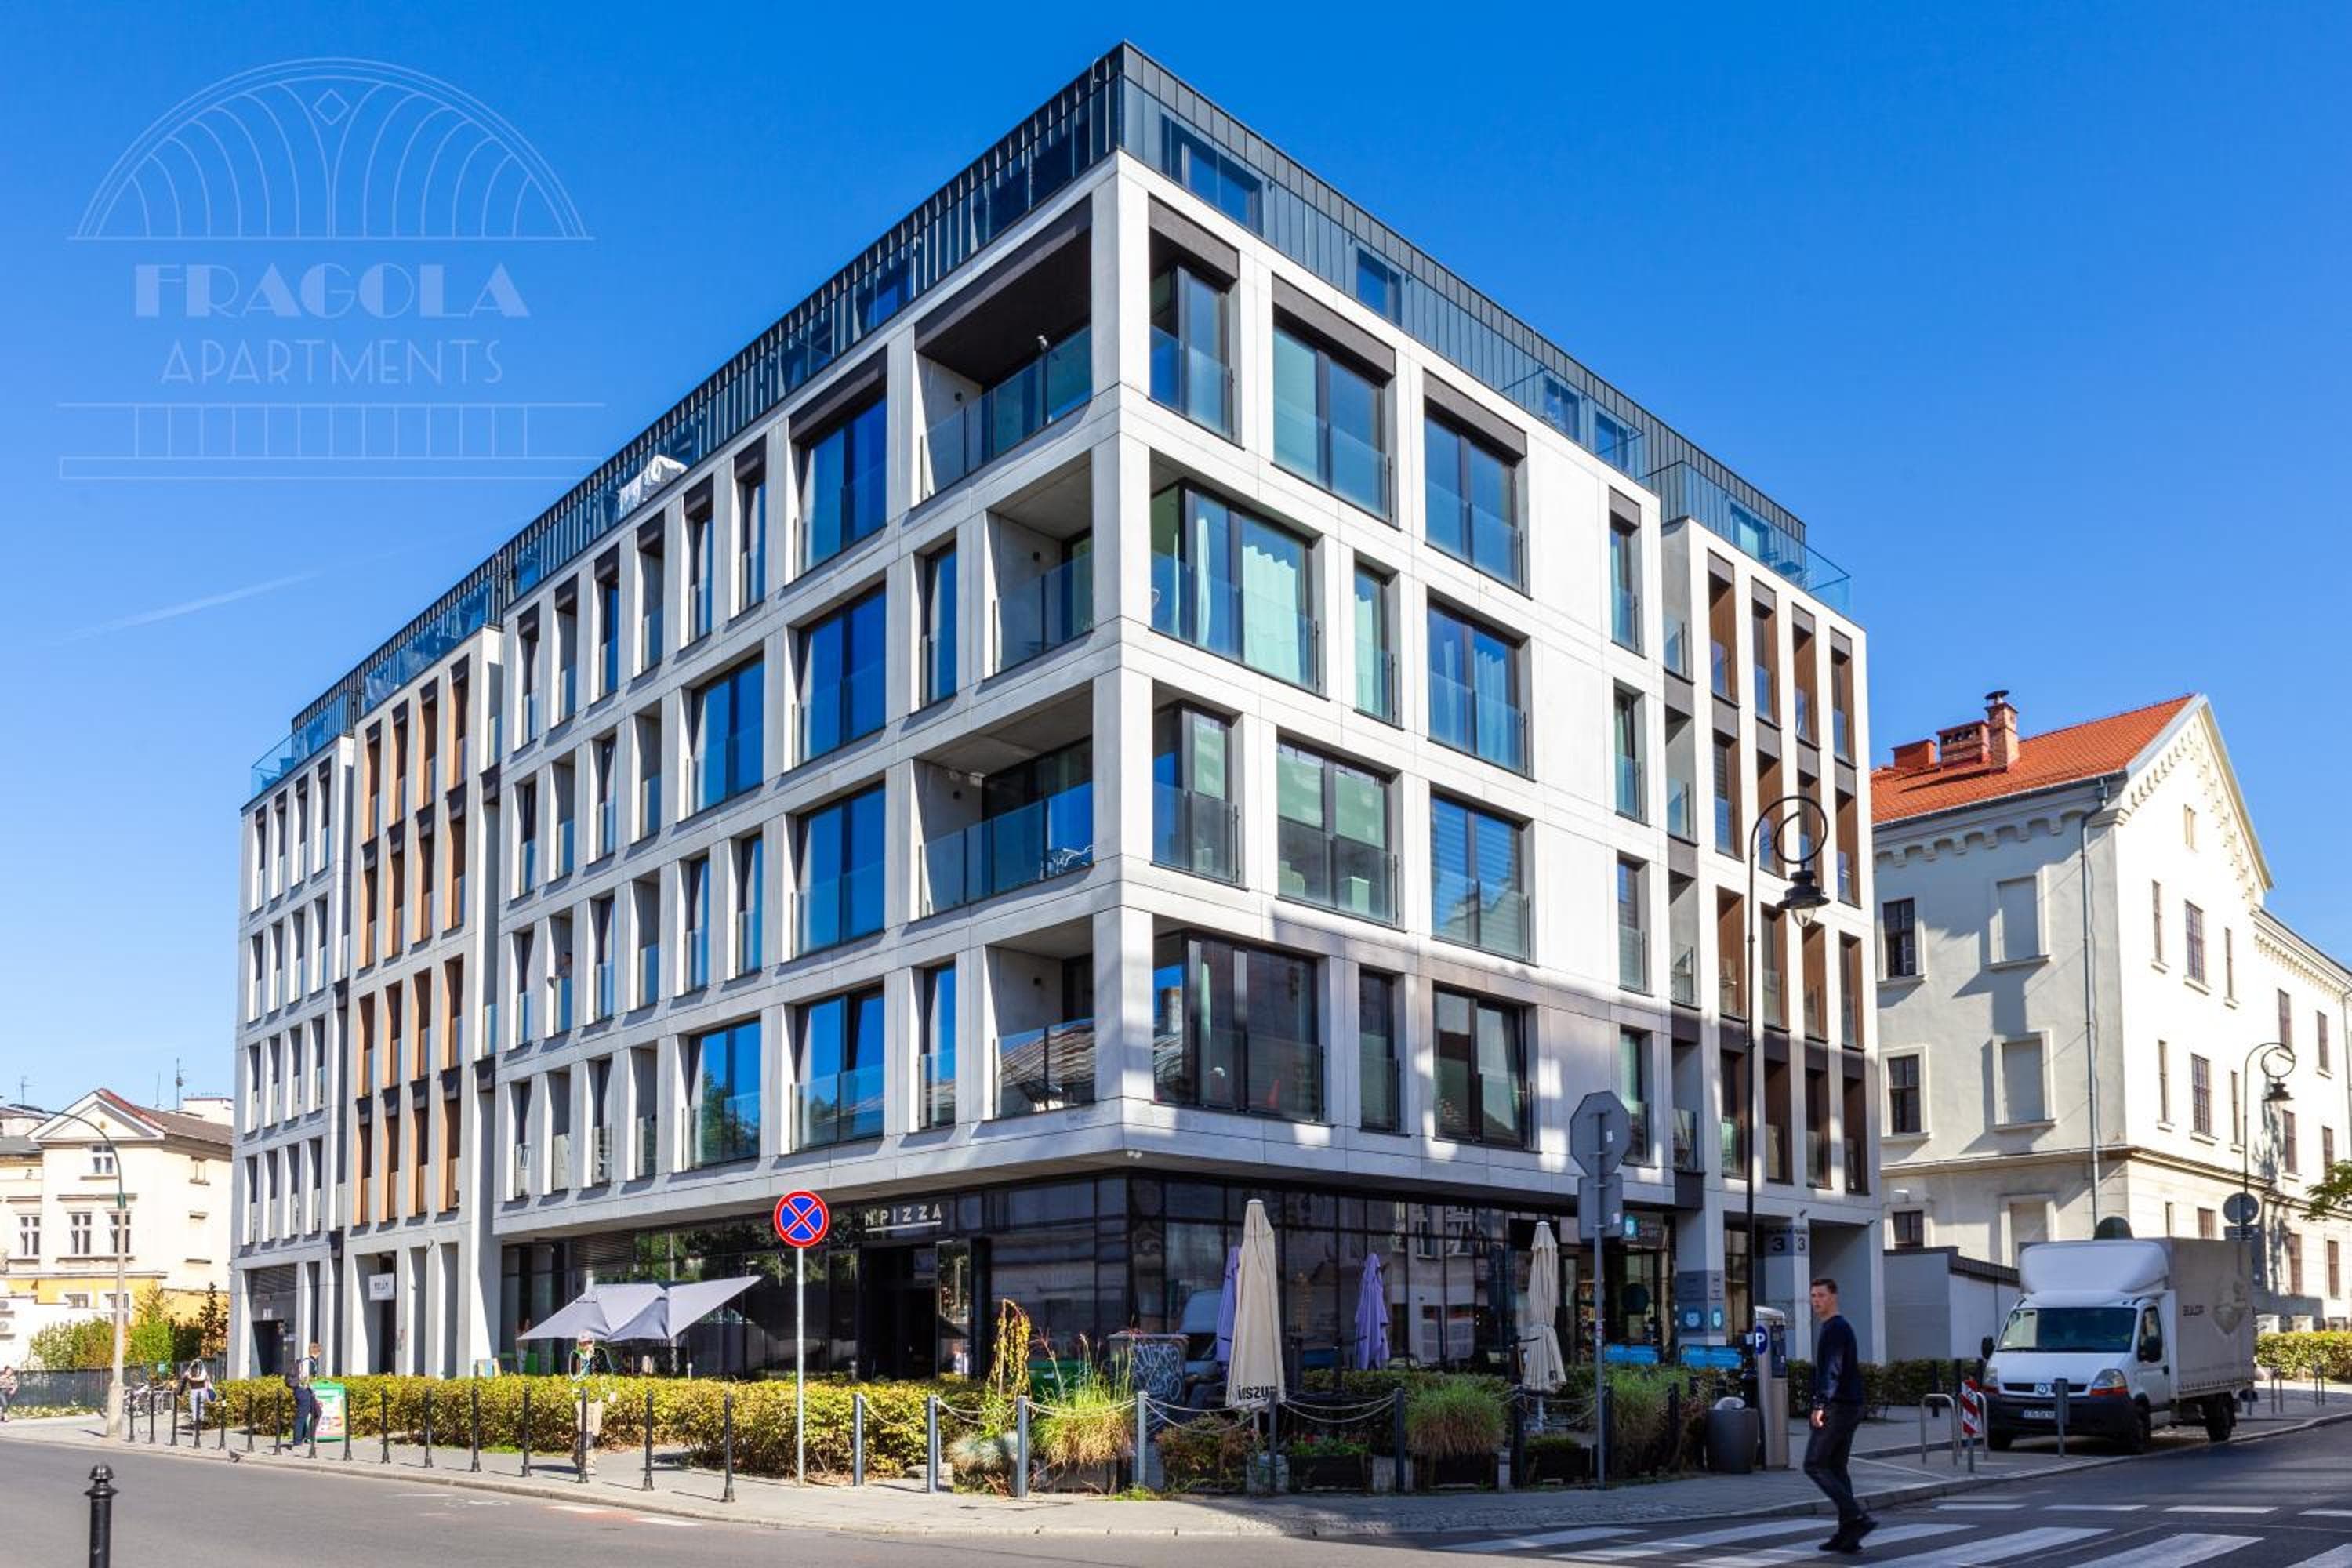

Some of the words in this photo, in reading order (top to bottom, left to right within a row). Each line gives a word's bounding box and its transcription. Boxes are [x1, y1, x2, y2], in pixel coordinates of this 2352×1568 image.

[1772, 1236, 1785, 1252] 3
[1798, 1236, 1806, 1252] 3
[1755, 1332, 1766, 1348] P
